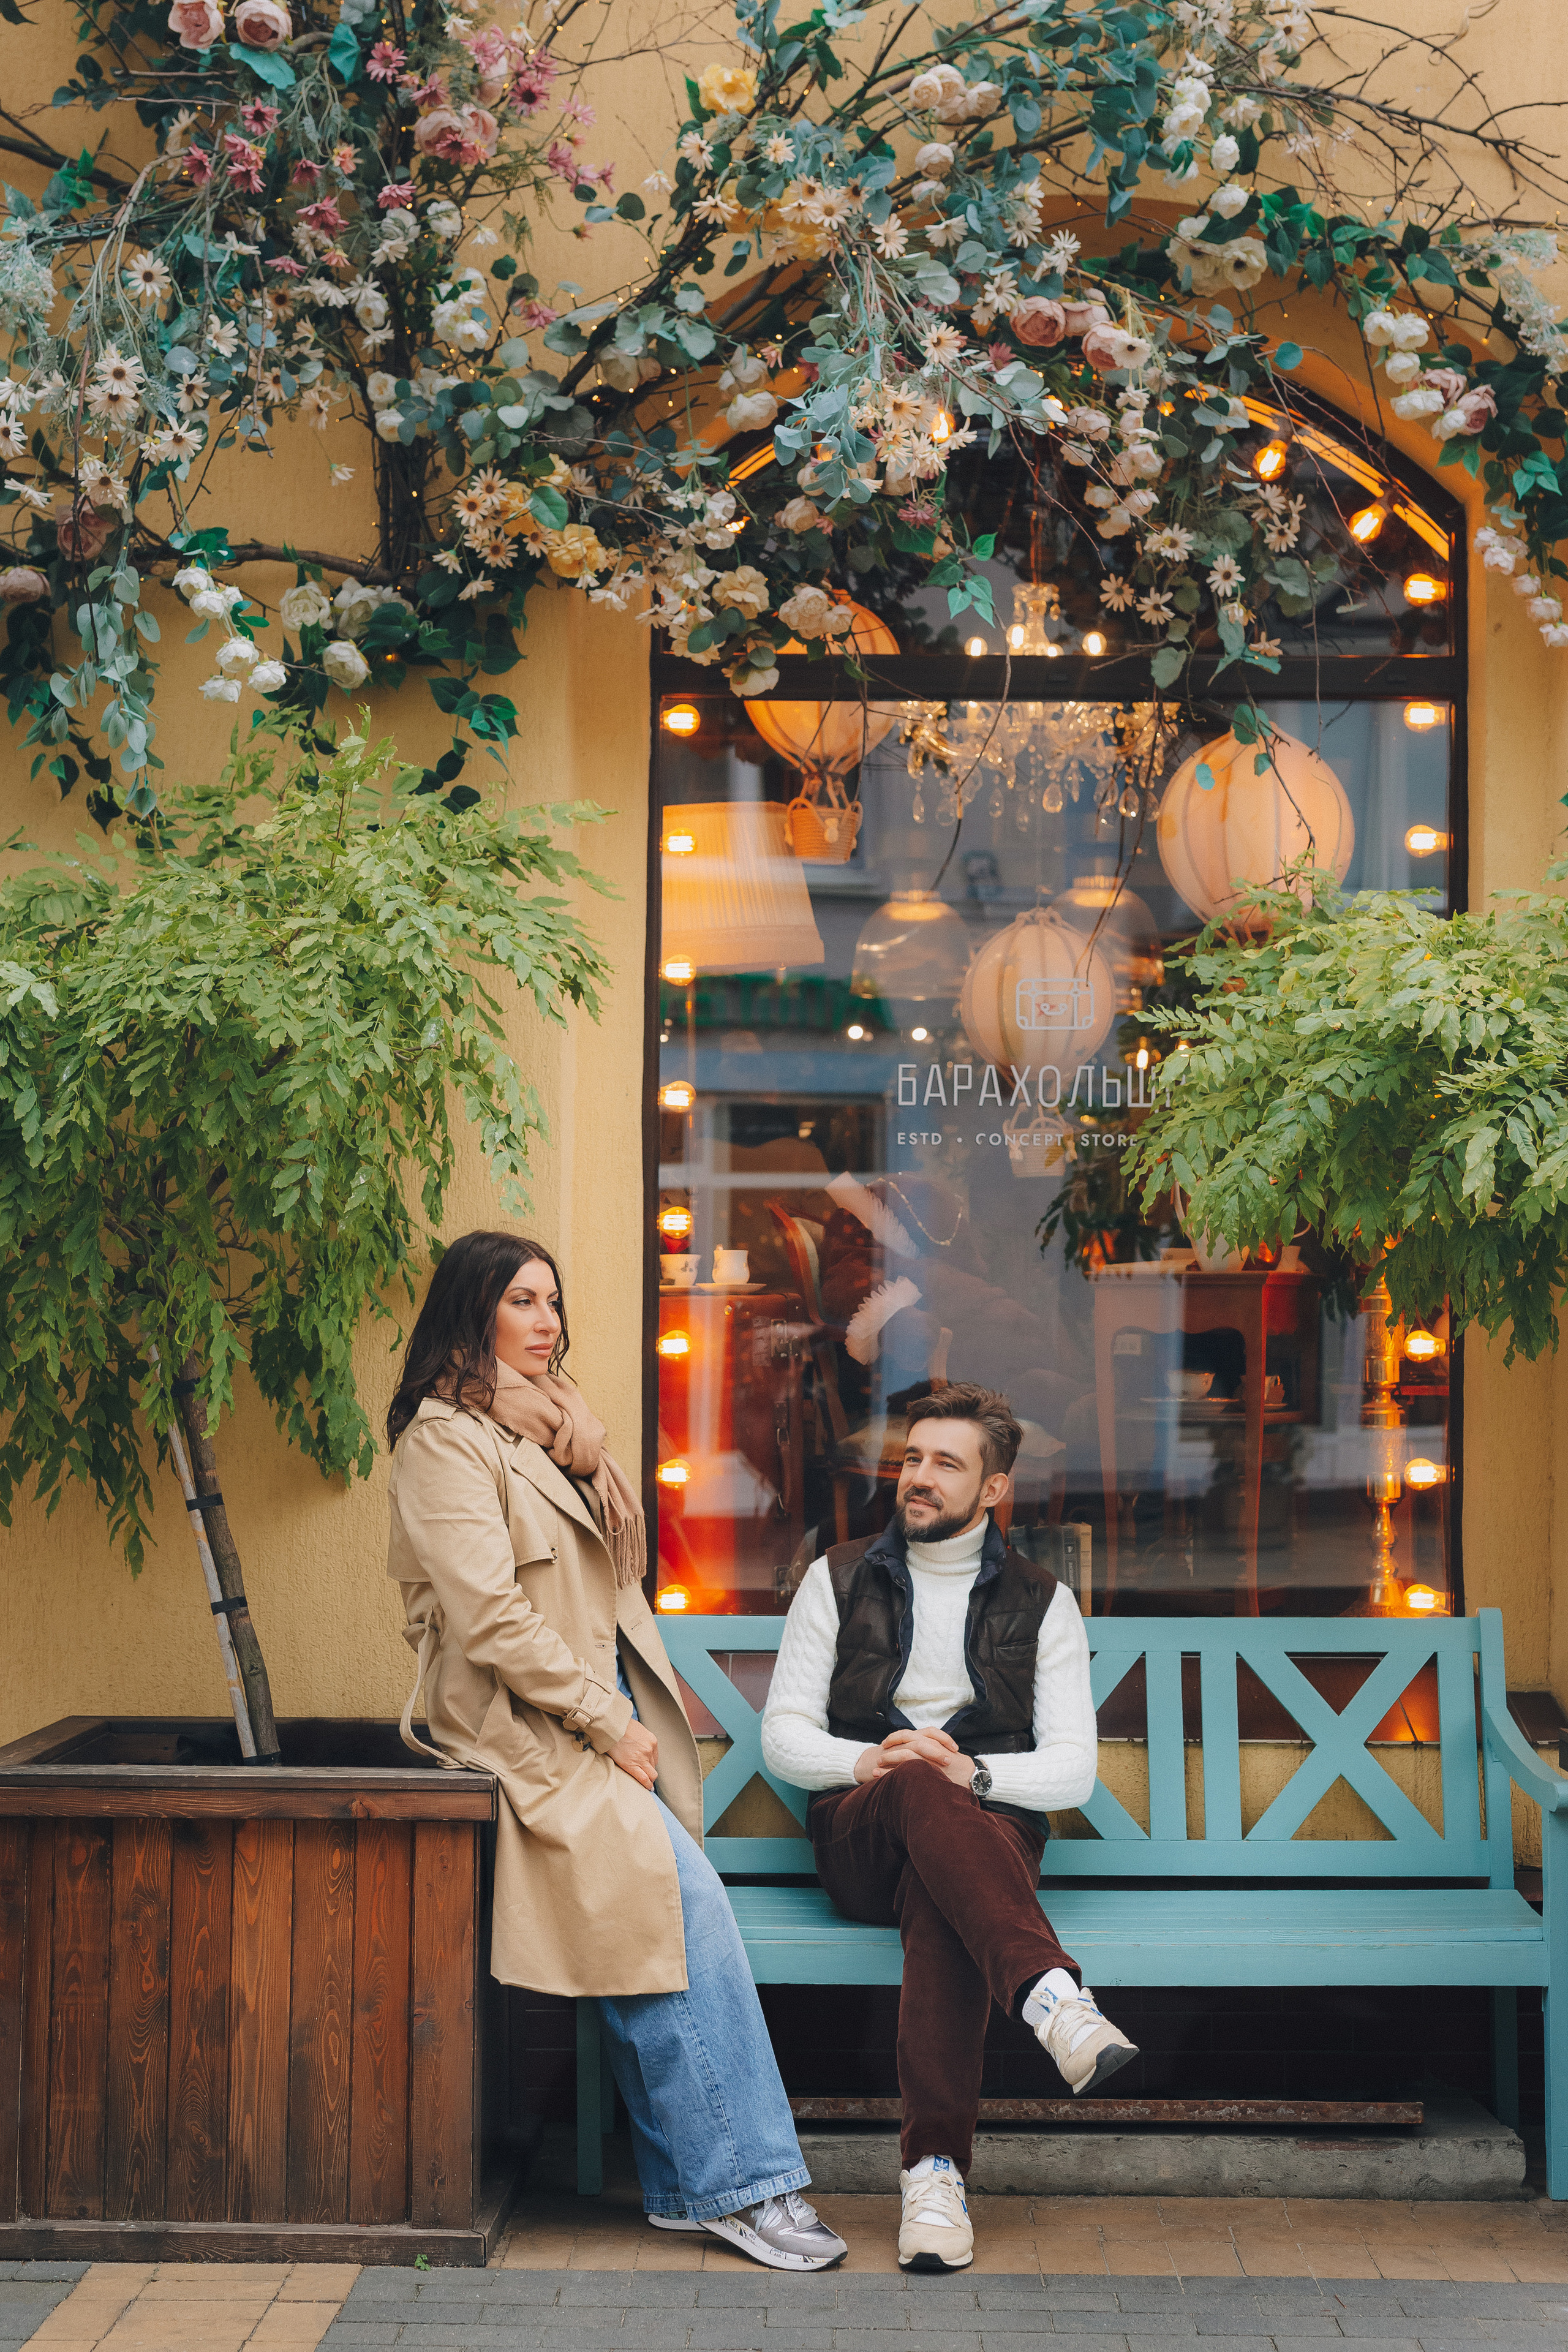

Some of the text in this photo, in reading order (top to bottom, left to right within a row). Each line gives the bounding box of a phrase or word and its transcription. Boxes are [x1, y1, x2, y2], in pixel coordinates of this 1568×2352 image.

[897, 1133, 1138, 1147] ESTD CONCEPT STORE
